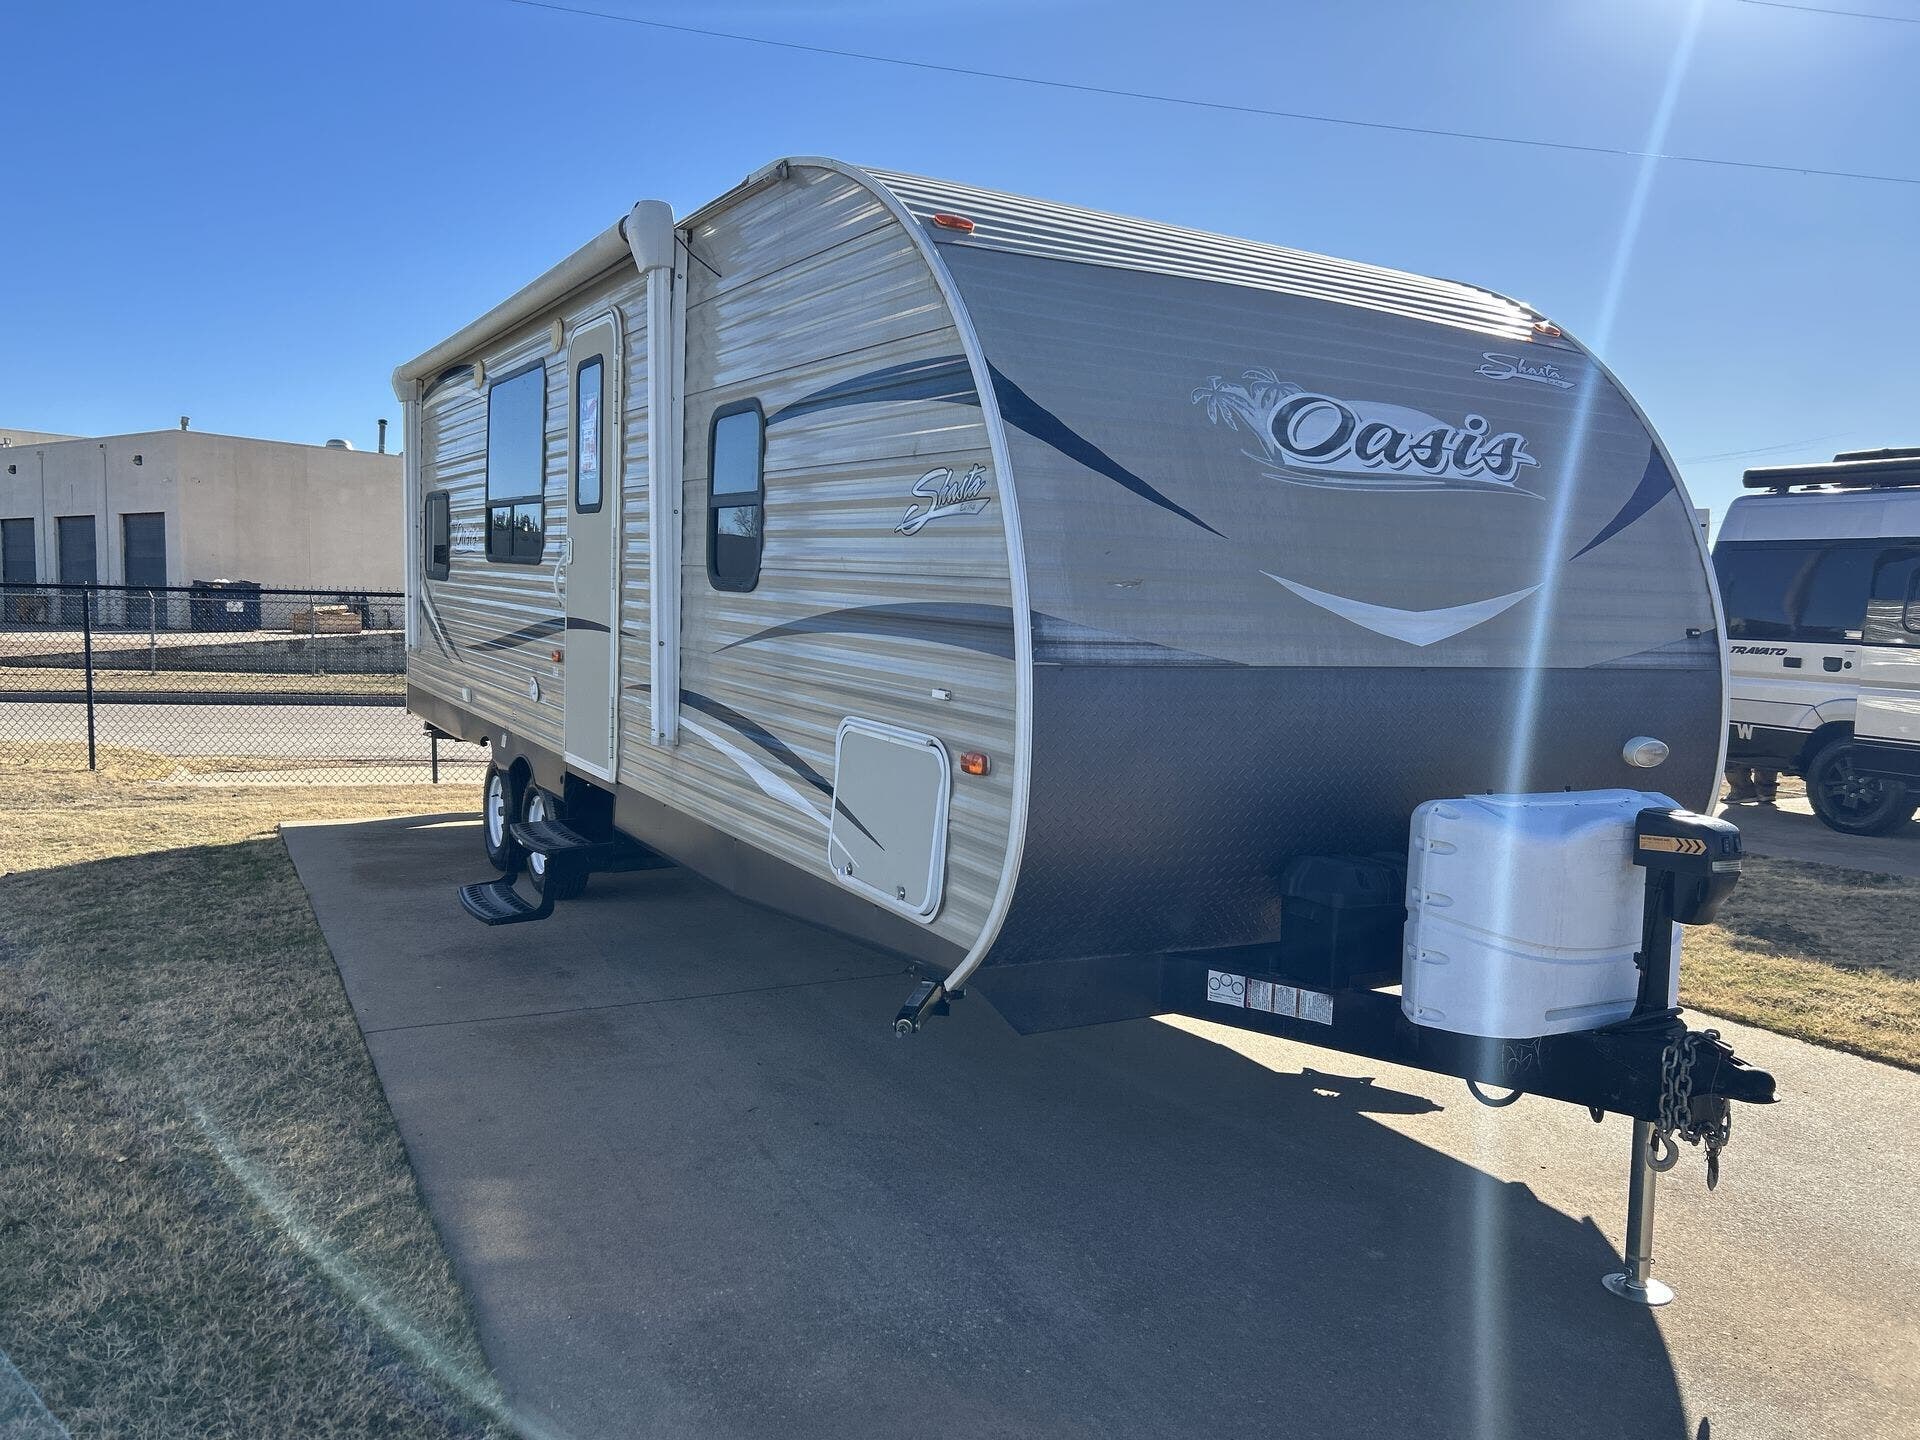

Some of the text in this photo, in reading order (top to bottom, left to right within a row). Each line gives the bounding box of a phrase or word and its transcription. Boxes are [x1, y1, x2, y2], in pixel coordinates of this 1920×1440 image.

[1475, 352, 1576, 388] Shasta
[1268, 391, 1541, 481] Oasis
[894, 463, 990, 536] Shasta
[1729, 645, 1788, 656] TRAVATO
